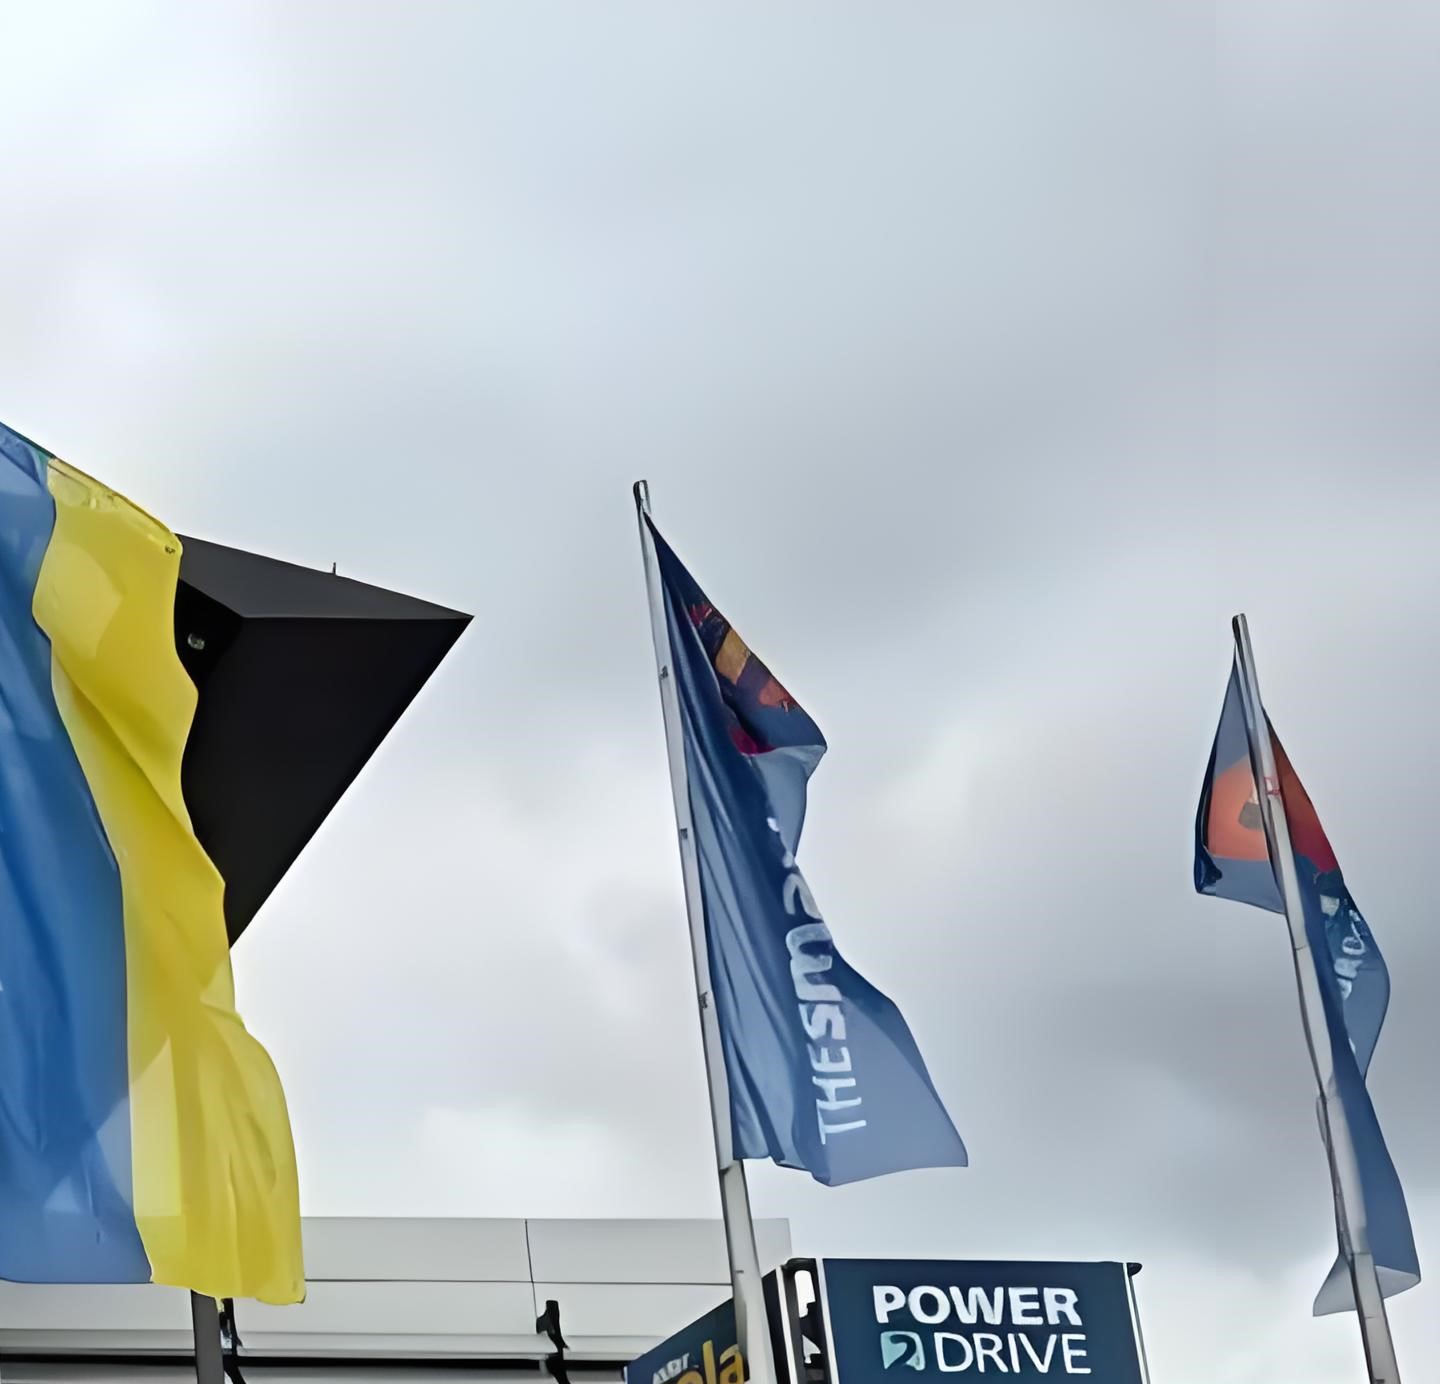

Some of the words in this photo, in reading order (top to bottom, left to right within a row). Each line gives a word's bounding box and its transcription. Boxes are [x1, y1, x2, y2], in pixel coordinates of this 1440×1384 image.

[806, 1043, 867, 1145] THE
[873, 1285, 1083, 1327] POWER
[880, 1331, 924, 1371] 2
[933, 1333, 1091, 1374] DRIVE
